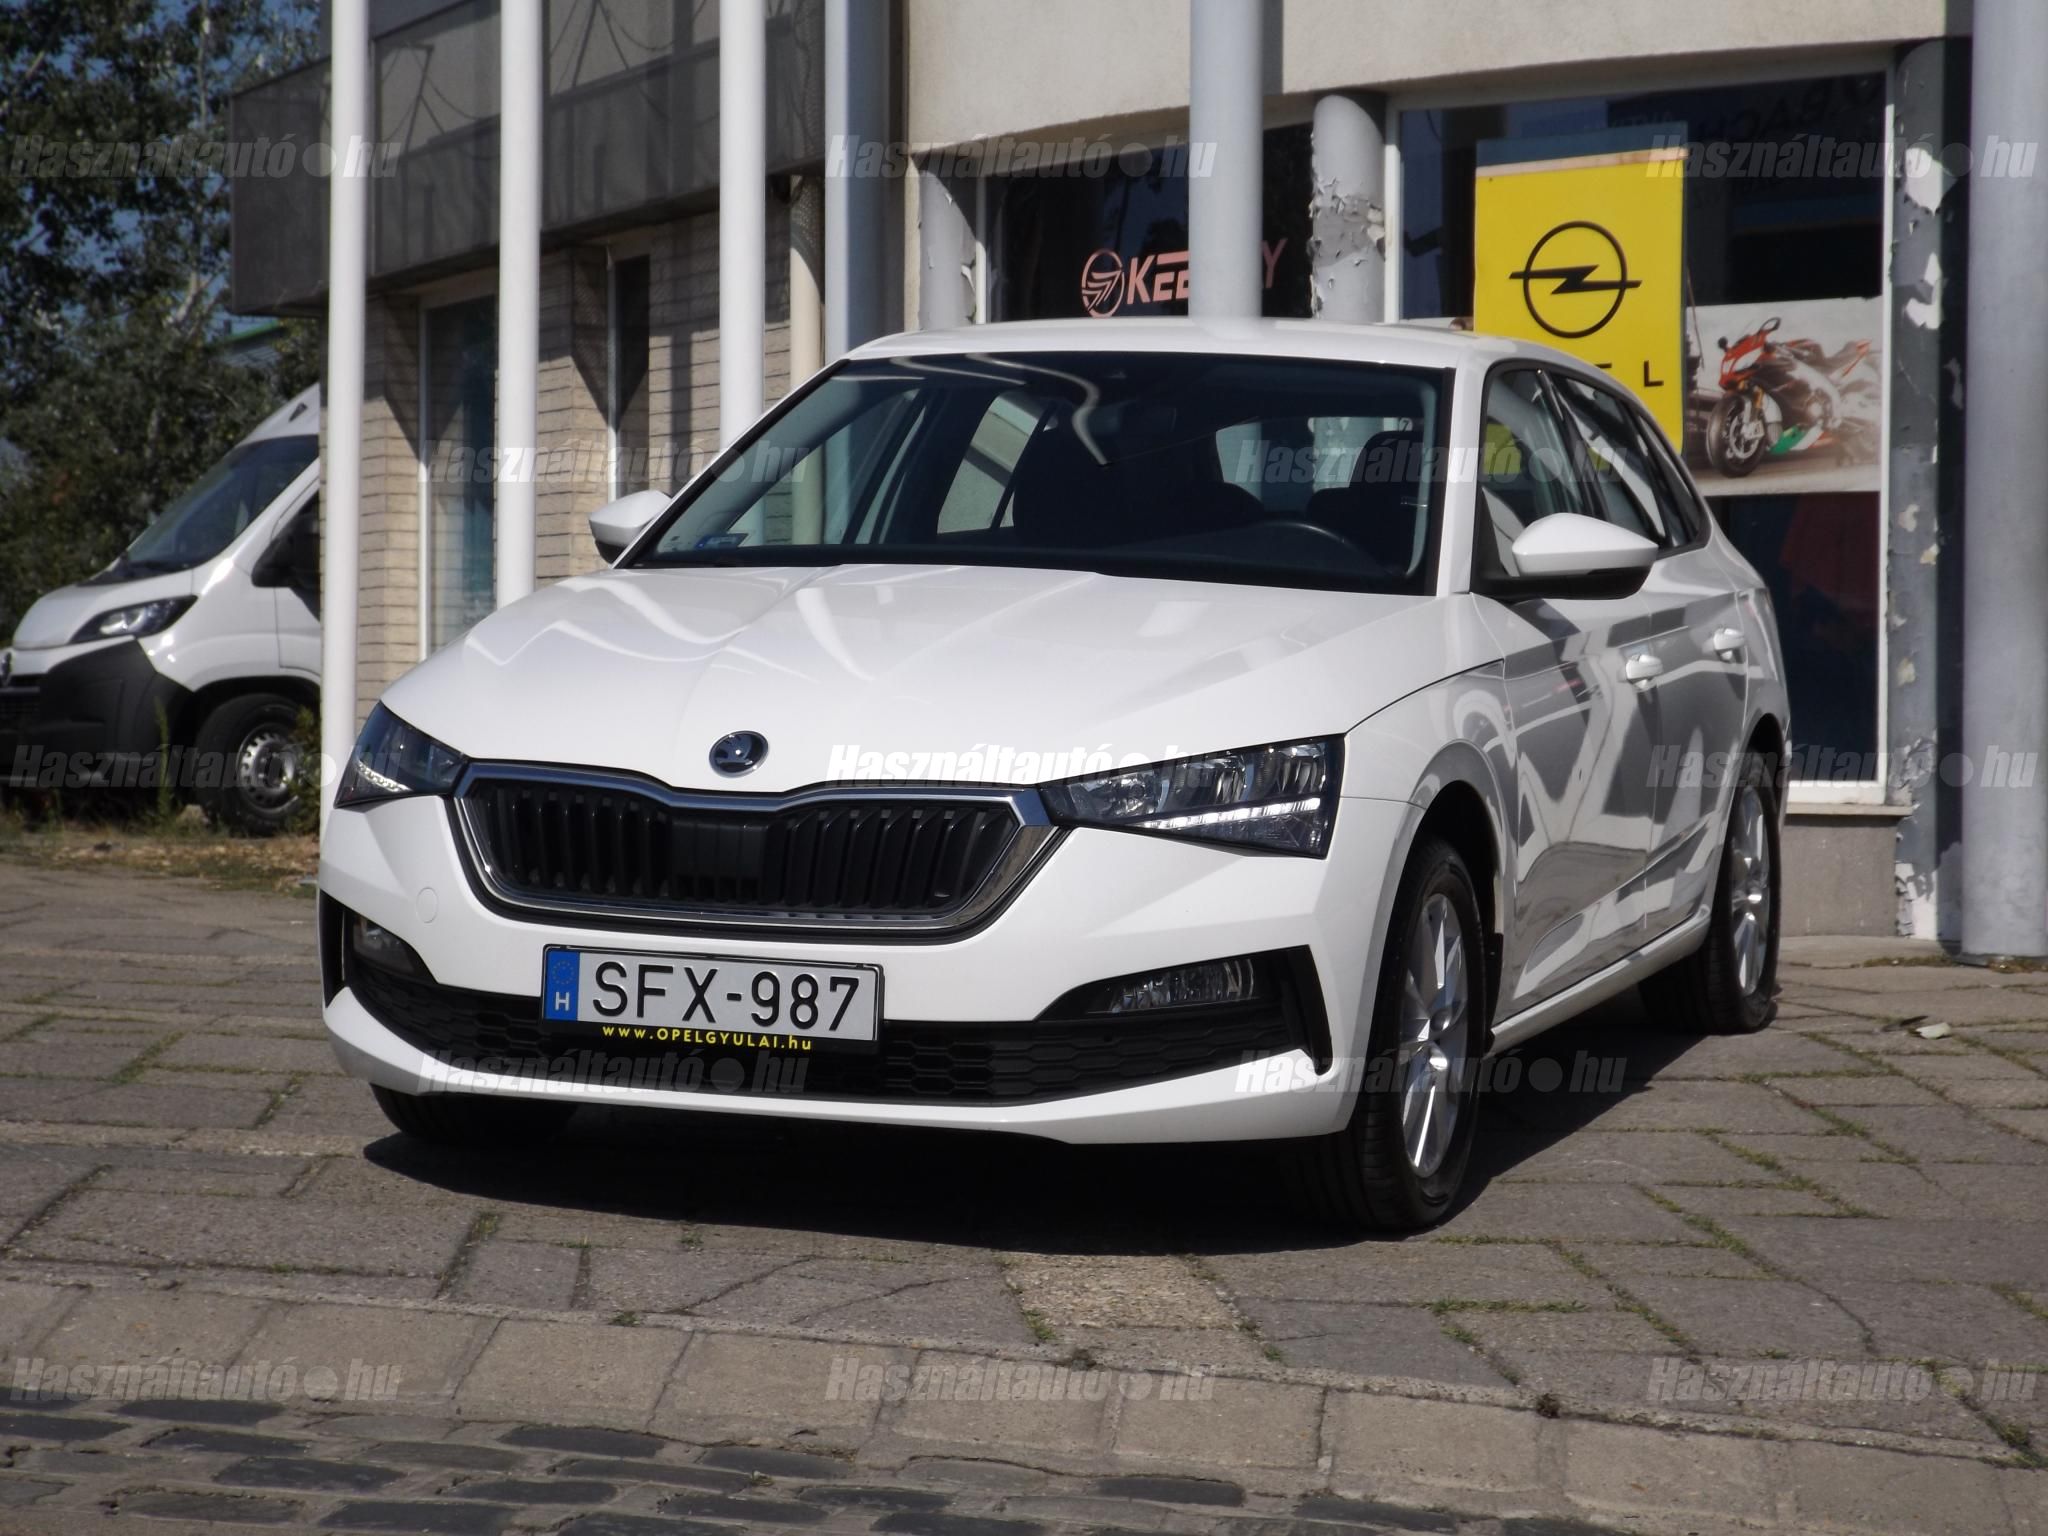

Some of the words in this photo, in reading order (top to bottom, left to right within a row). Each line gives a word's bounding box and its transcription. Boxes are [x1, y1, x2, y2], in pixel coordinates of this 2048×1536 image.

[555, 991, 570, 1011] H
[592, 960, 860, 1033] SFX-987
[602, 1025, 812, 1050] www.OPELGYULAI.hu
